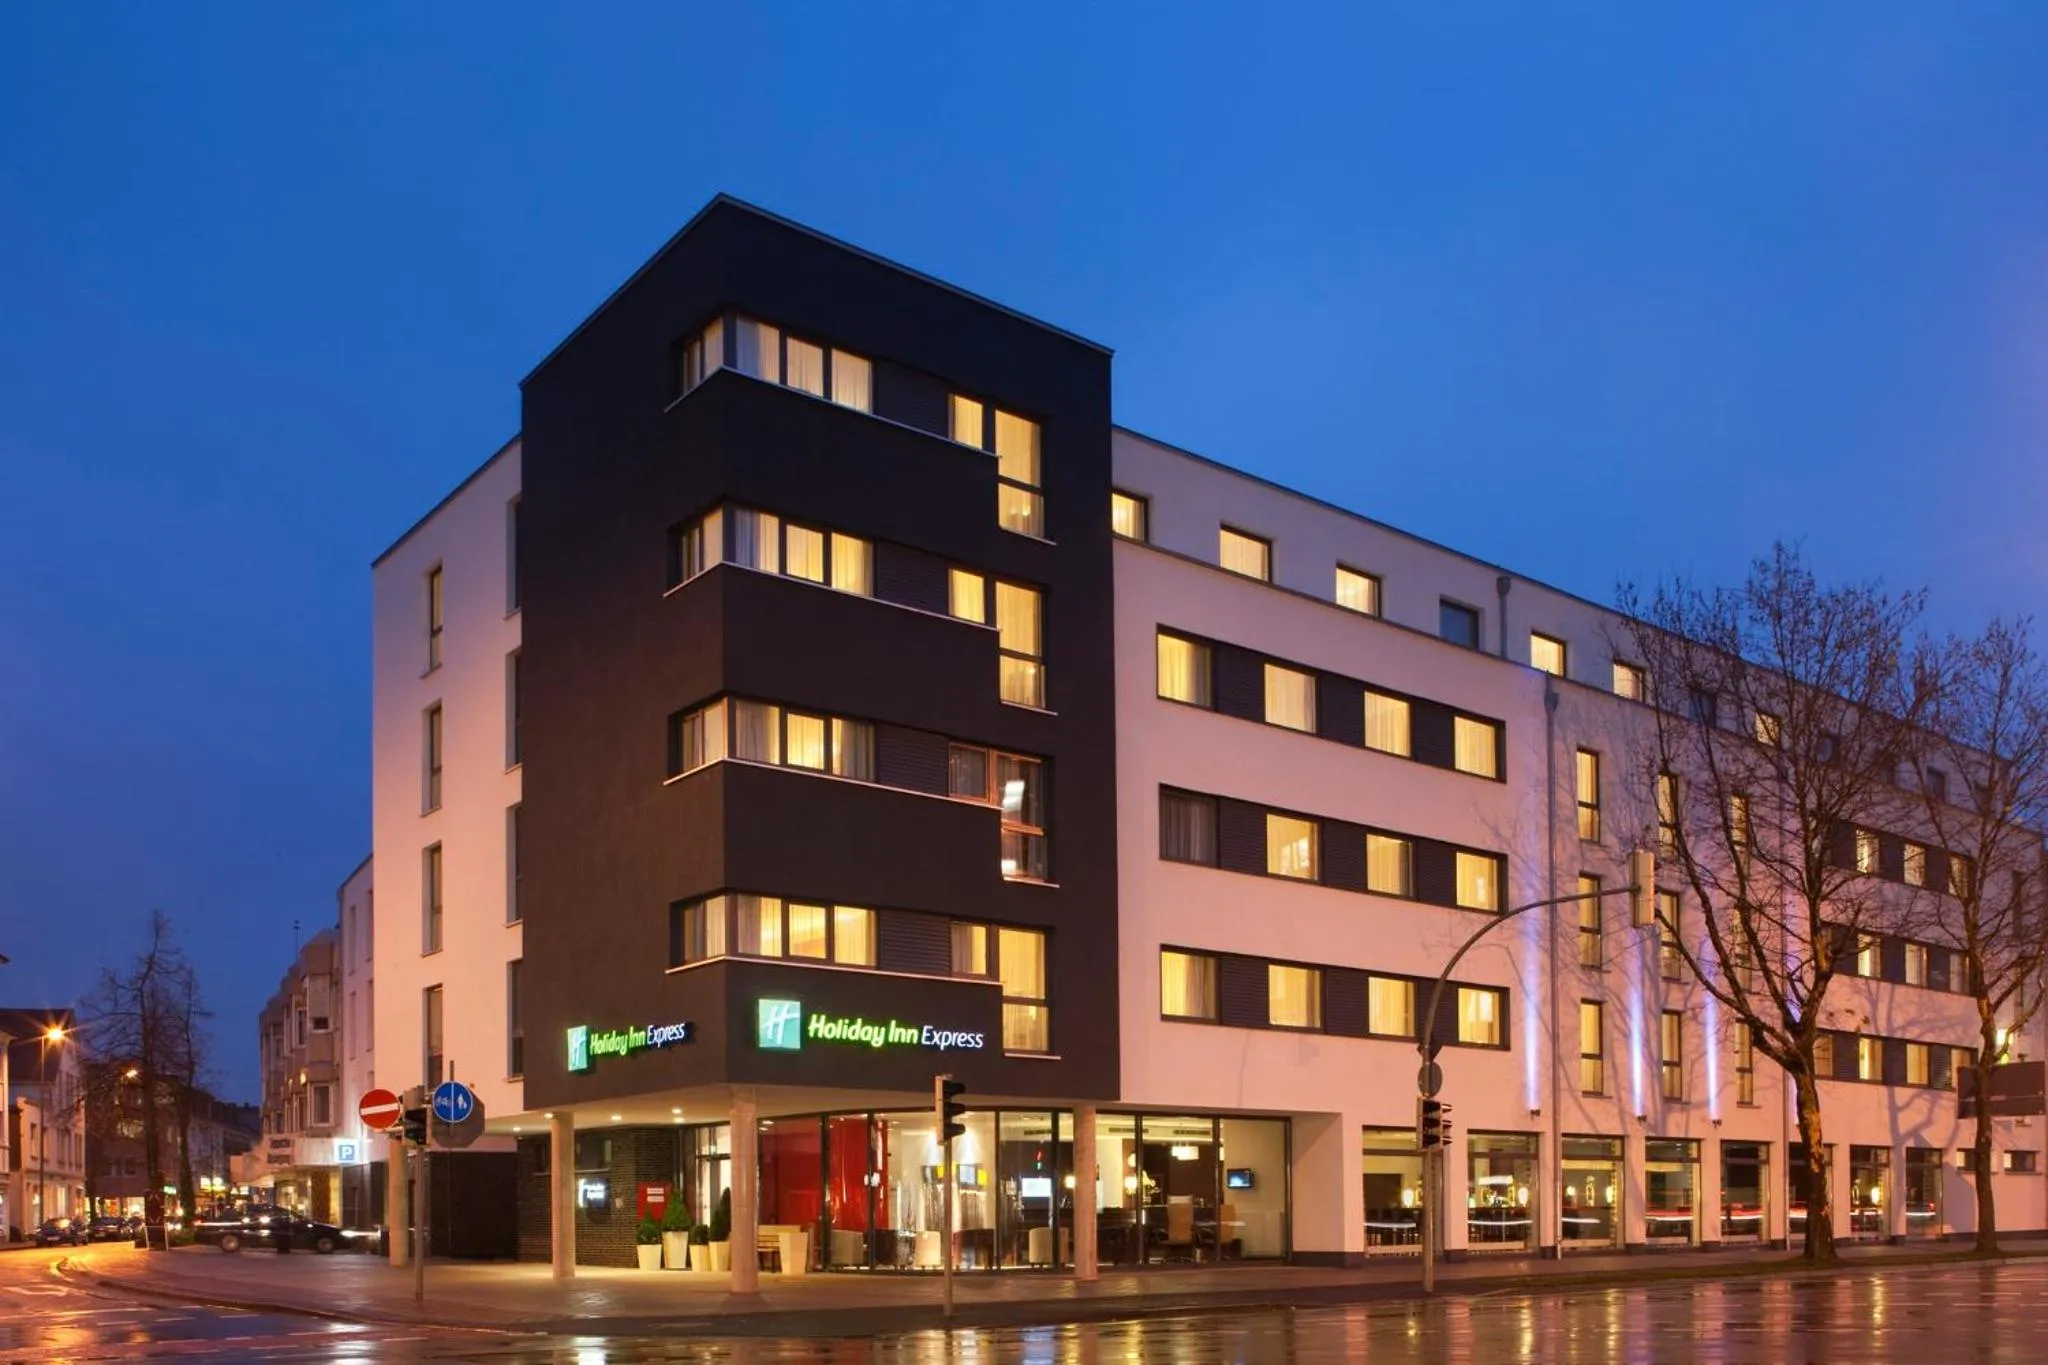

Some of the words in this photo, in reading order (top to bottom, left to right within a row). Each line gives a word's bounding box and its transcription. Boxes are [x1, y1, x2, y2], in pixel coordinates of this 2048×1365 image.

[589, 1030, 628, 1056] Holiday
[628, 1025, 646, 1048] Inn
[647, 1023, 685, 1047] Express
[808, 1013, 885, 1048] Holiday
[888, 1019, 918, 1044] Inn
[921, 1025, 984, 1050] Express
[341, 1146, 353, 1159] P
